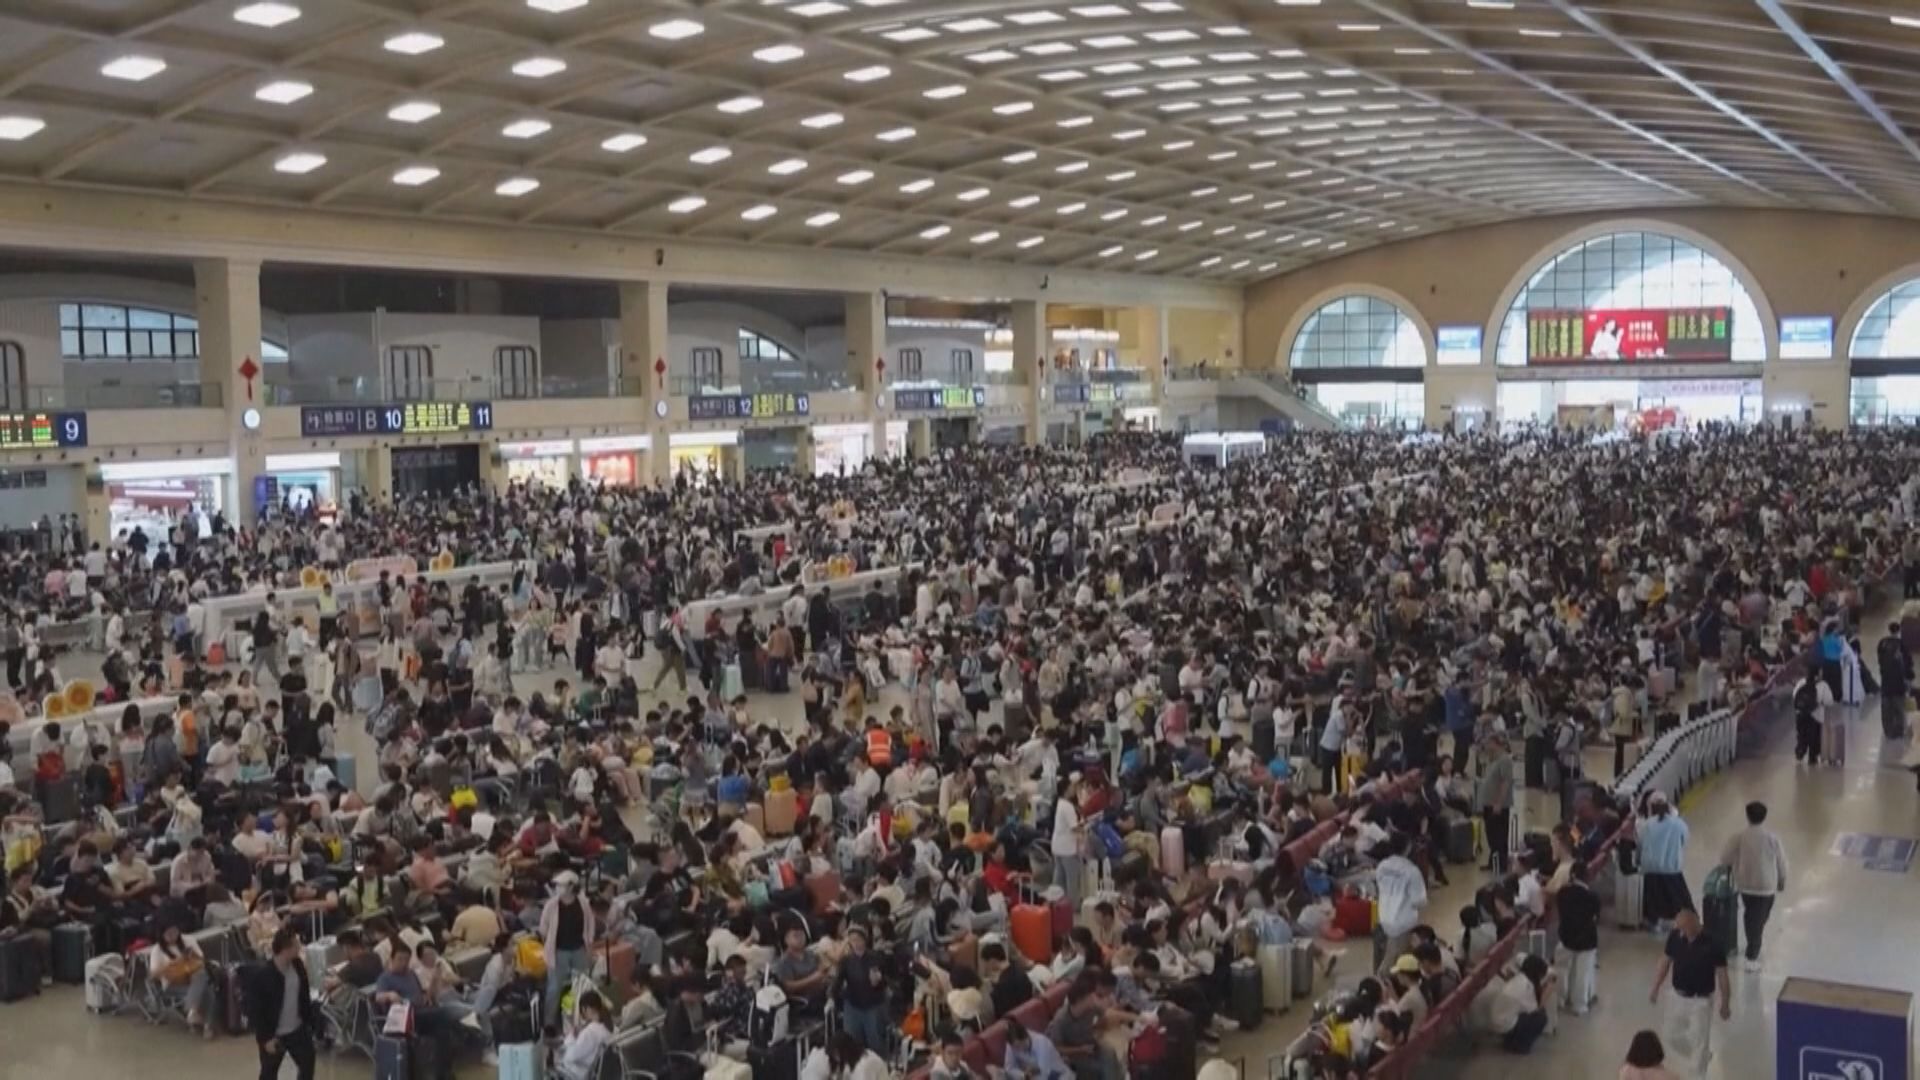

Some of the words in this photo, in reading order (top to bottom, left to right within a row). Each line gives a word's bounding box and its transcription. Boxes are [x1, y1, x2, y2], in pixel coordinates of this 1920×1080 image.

[740, 398, 752, 415] 12
[798, 397, 808, 412] 13
[365, 410, 377, 430] B
[385, 408, 401, 429] 10
[477, 407, 490, 426] 11
[65, 418, 79, 441] 9
